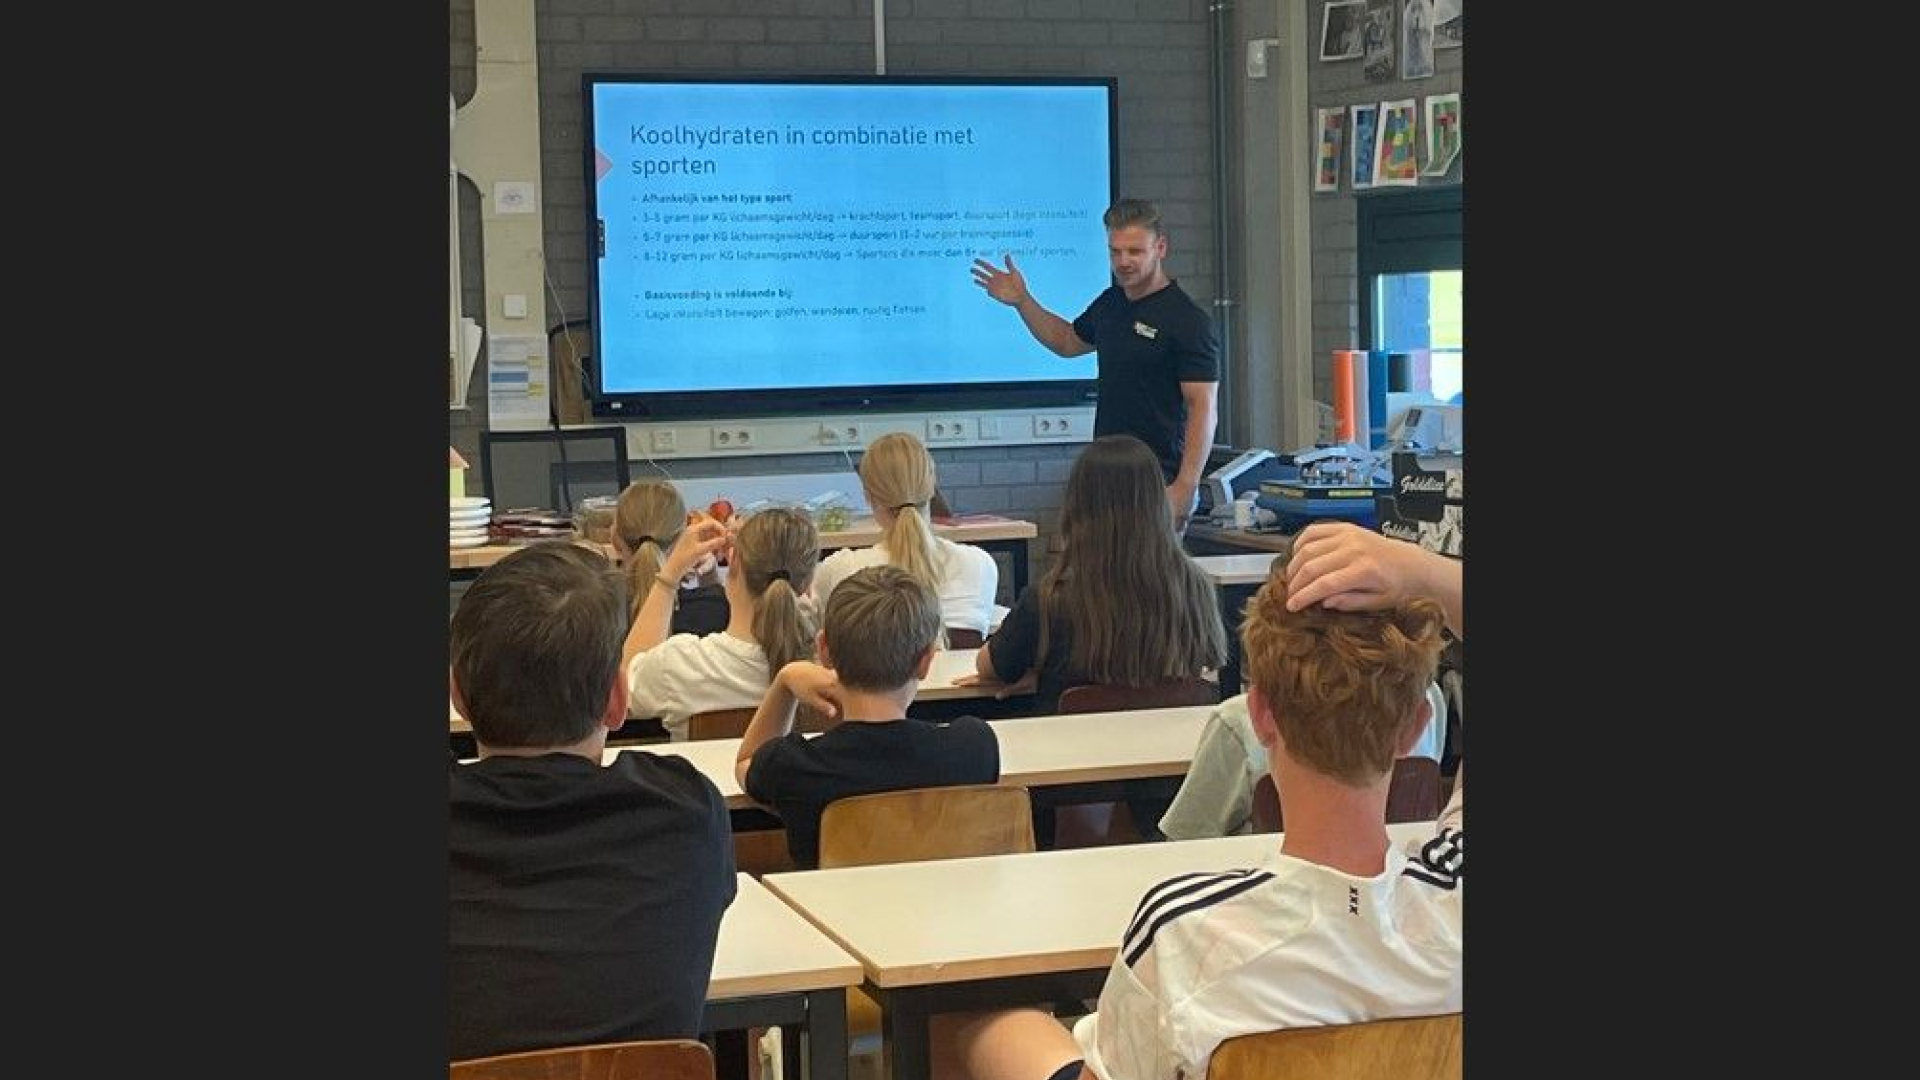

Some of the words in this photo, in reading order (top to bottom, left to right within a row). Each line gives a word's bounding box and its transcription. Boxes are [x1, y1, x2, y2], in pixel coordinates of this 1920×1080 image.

[630, 125, 778, 149] Koolhydraten
[787, 126, 804, 144] in
[812, 125, 927, 145] combinatie
[935, 127, 974, 145] met
[631, 156, 716, 178] sporten
[641, 193, 699, 205] Afhankelijk
[701, 194, 718, 203] van
[722, 193, 737, 203] het
[741, 193, 762, 206] type
[664, 213, 689, 225] gram
[693, 213, 709, 224] per
[712, 212, 728, 222] KG
[664, 233, 689, 244] gram
[693, 232, 709, 244] per
[714, 231, 728, 241] KG
[670, 251, 696, 263] gram
[700, 251, 715, 263] per
[720, 251, 734, 261] KG
[945, 248, 959, 258] dan
[644, 289, 711, 301] Basisvoeding
[713, 289, 722, 298] is
[725, 288, 776, 299] voldoende
[645, 309, 670, 321] Lage
